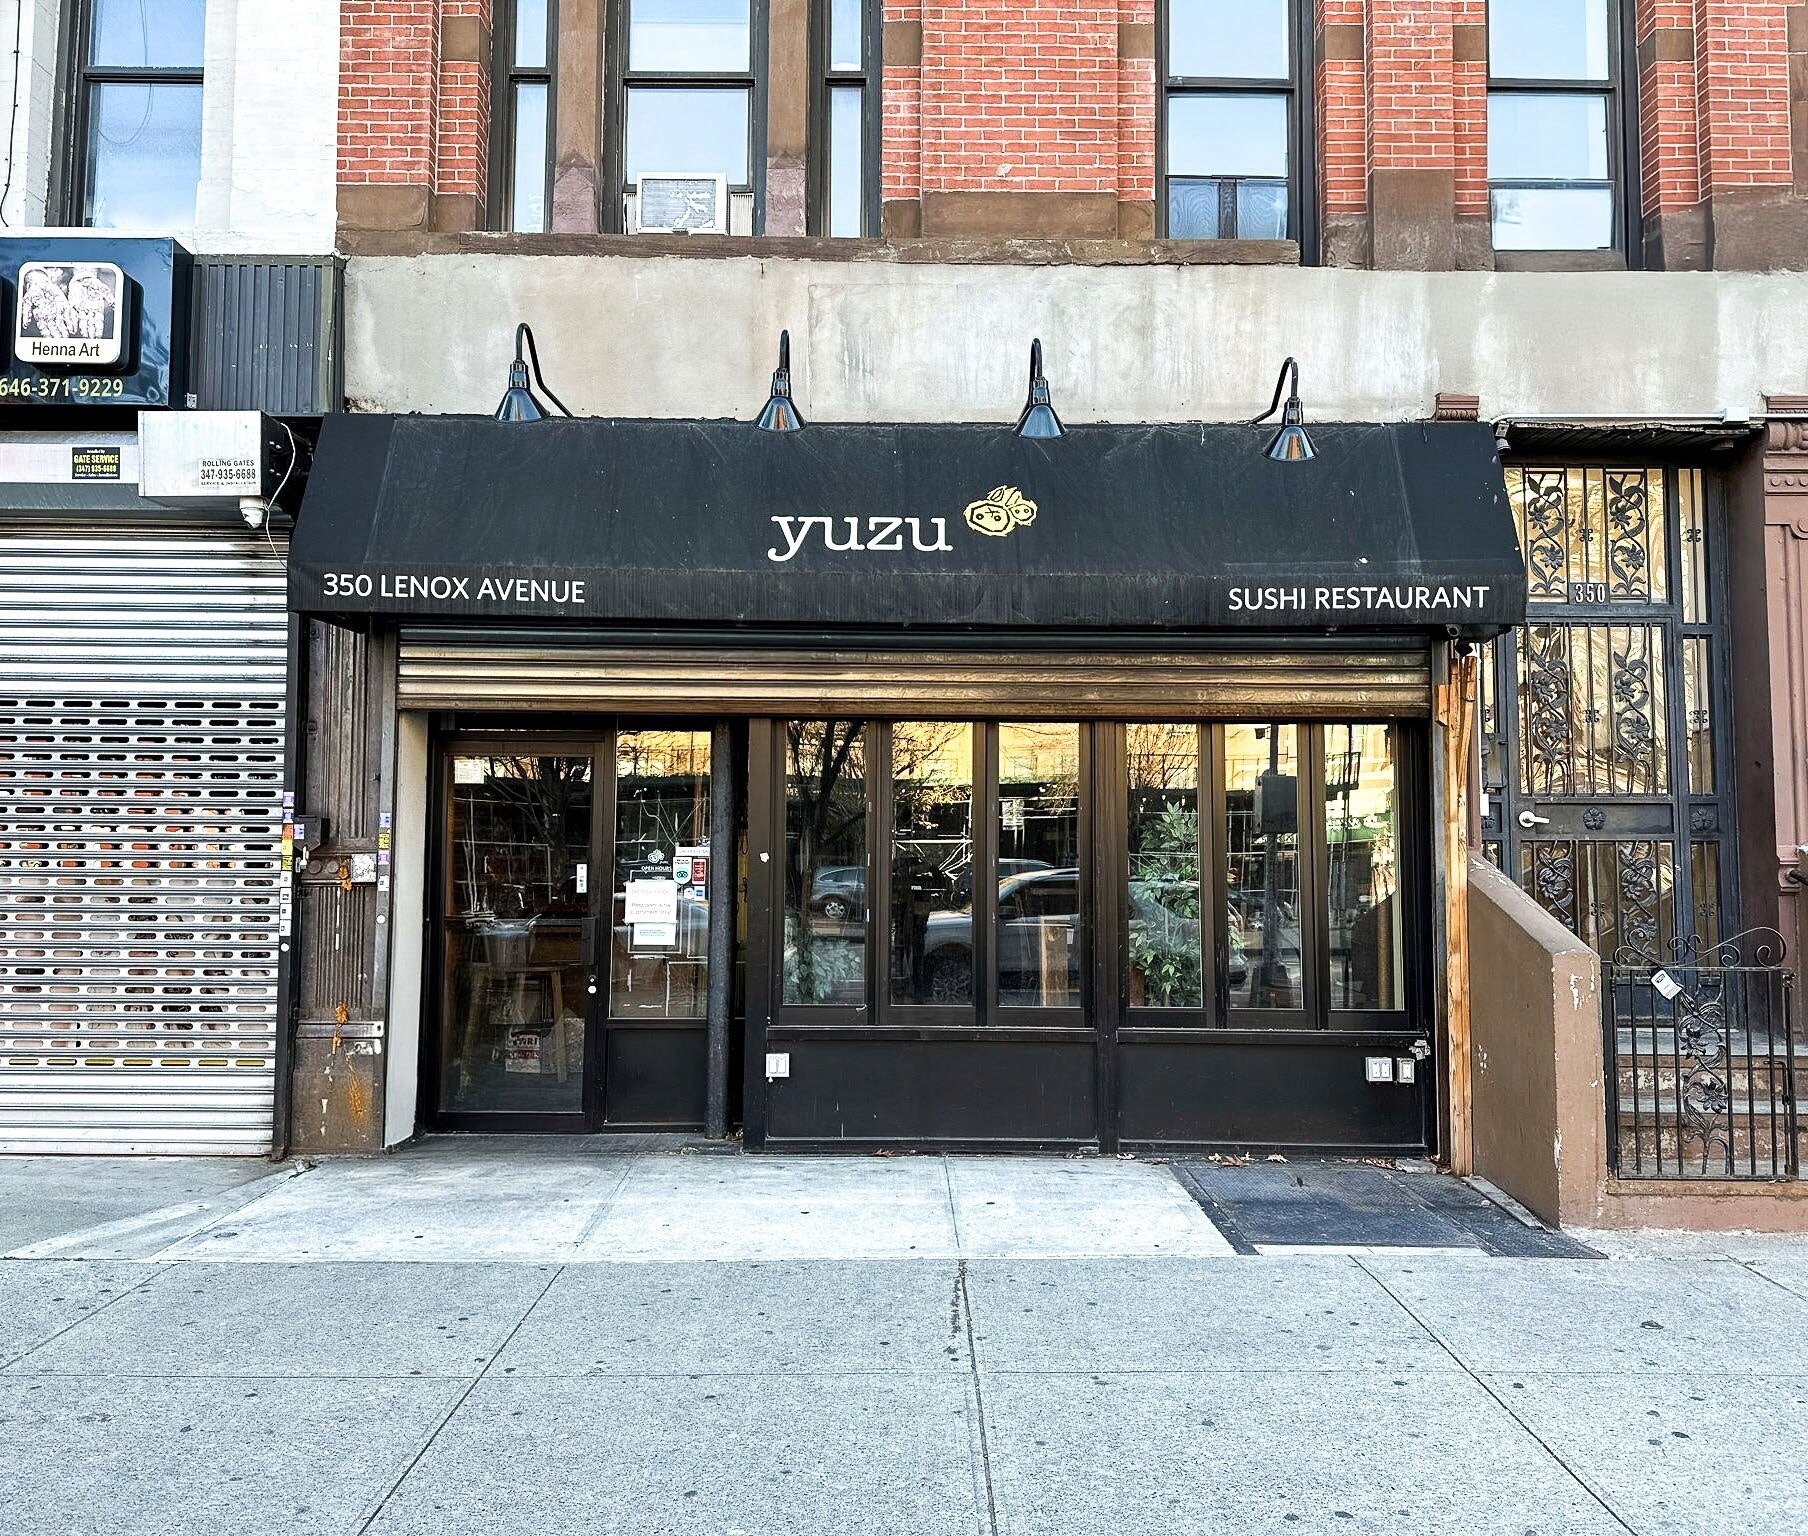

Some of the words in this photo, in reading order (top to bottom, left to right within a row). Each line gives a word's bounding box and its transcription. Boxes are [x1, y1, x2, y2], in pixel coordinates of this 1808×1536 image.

[32, 341, 76, 356] Henna
[79, 342, 100, 357] Art
[0, 378, 123, 397] 646-371-9229
[73, 454, 91, 464] GATE
[91, 454, 119, 464] SERVICE
[233, 459, 255, 467] GATES
[767, 515, 954, 562] yuzu
[323, 573, 373, 597] 350
[380, 574, 470, 600] LENOX
[476, 577, 586, 604] AVENUE
[1575, 583, 1606, 603] 350
[1228, 587, 1306, 611] SUSHI
[1314, 586, 1490, 610] RESTAURANT
